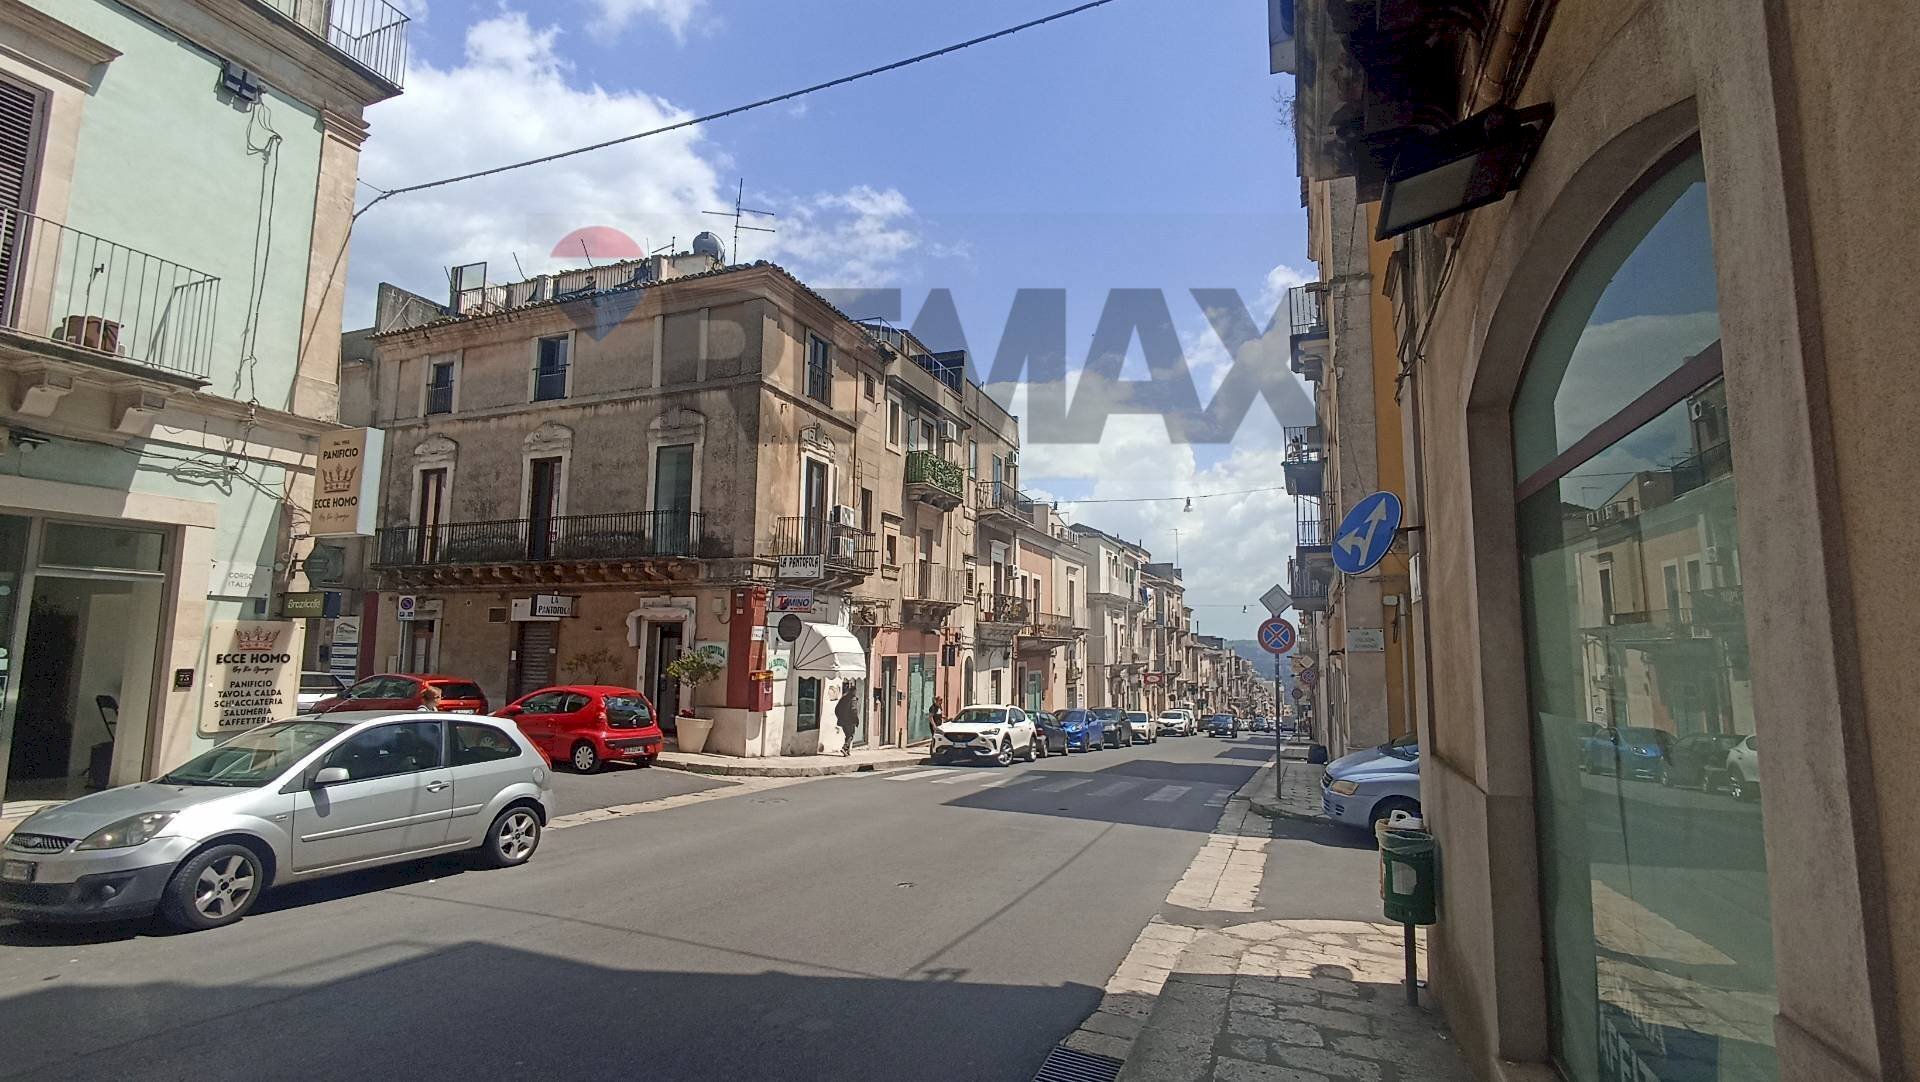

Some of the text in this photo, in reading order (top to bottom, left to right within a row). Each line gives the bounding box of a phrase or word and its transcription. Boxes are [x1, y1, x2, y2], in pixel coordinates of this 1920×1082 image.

[323, 447, 359, 460] PANIFICIO
[314, 496, 358, 509] ECCE HOMO
[780, 556, 819, 568] LA PANTOFOLA
[228, 572, 254, 580] CORSO
[551, 596, 559, 604] LA
[216, 653, 291, 665] ECCE HOMO
[230, 680, 273, 688] PANIFICIO
[218, 690, 252, 698] TAVOLA
[214, 698, 283, 708] SCHIACCIATERIA
[224, 707, 272, 717] SALUMERIA
